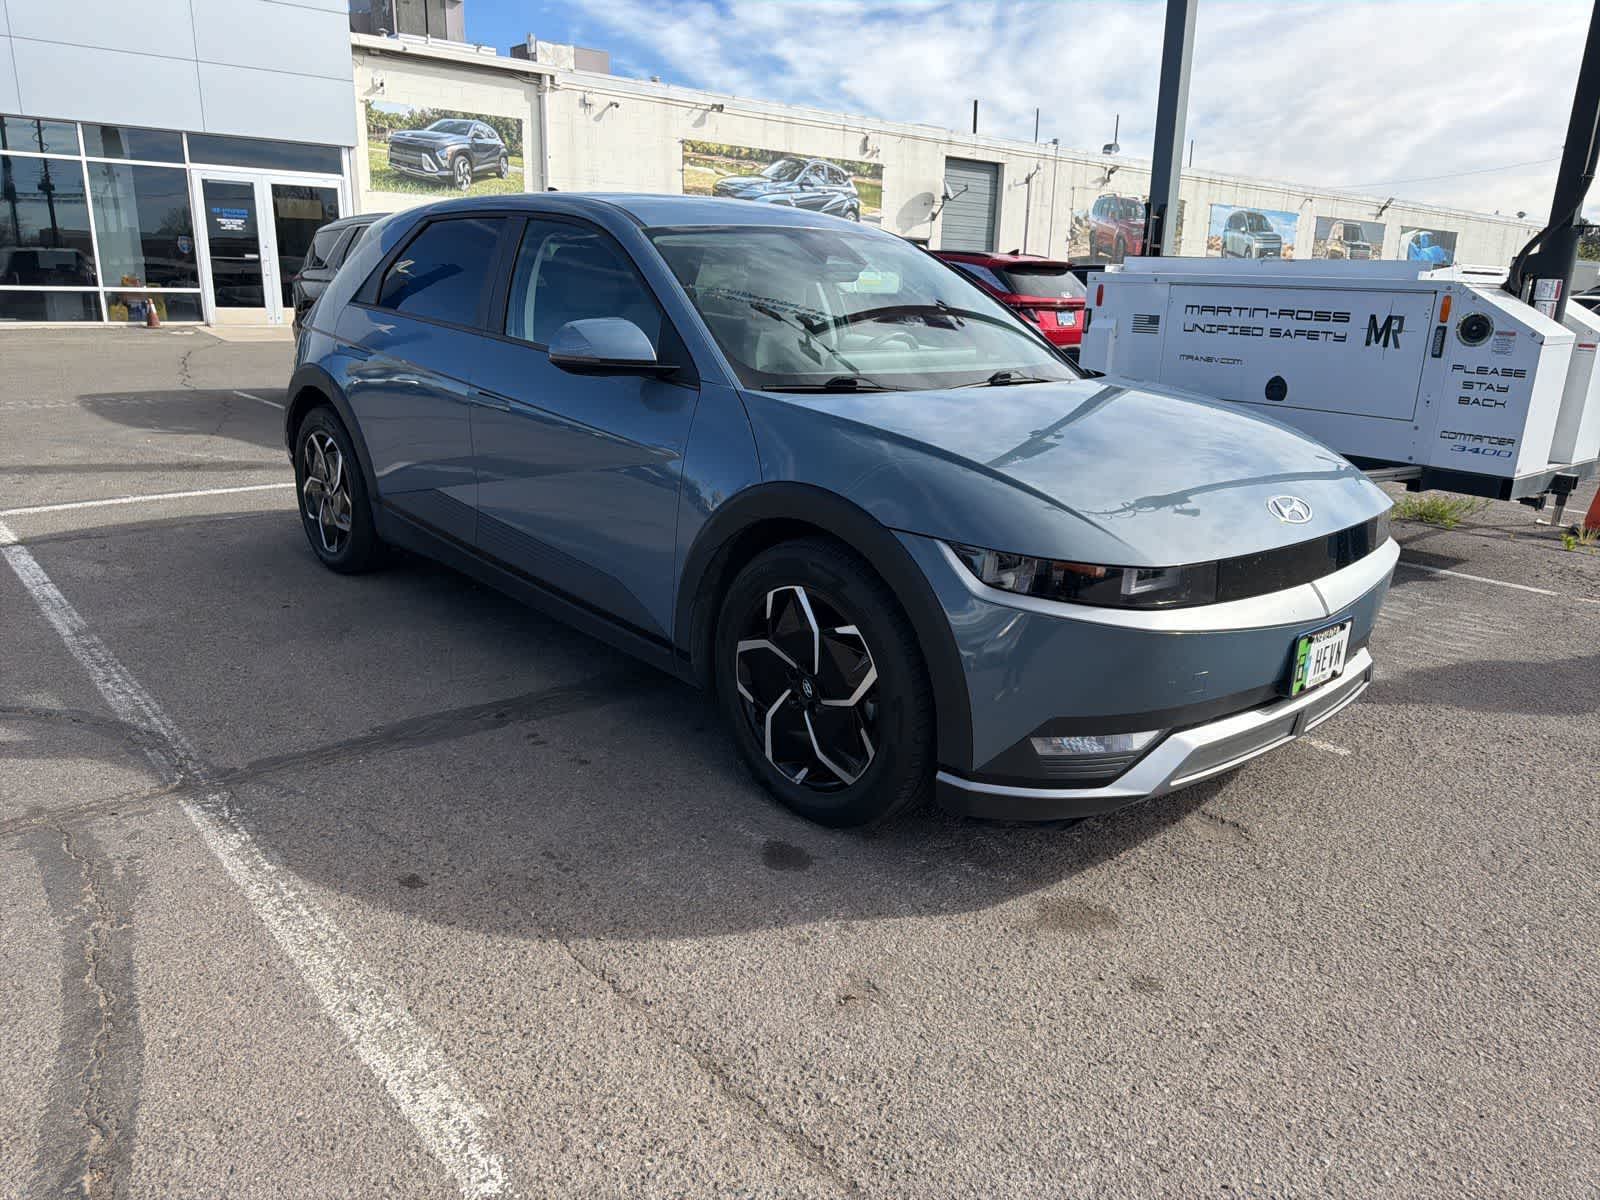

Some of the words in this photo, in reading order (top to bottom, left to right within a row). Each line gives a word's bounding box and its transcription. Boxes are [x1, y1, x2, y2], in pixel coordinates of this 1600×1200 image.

[1184, 304, 1351, 323] MARTIN-ROSS
[1183, 322, 1264, 337] UNIFIED
[1269, 327, 1348, 343] SAFETY
[1451, 364, 1527, 378] PLEASE
[1462, 381, 1510, 393] STAY
[1458, 396, 1507, 408] BACK
[1440, 430, 1516, 447] COMMANDER
[1450, 444, 1513, 458] 3400
[1313, 639, 1344, 677] HEVN
